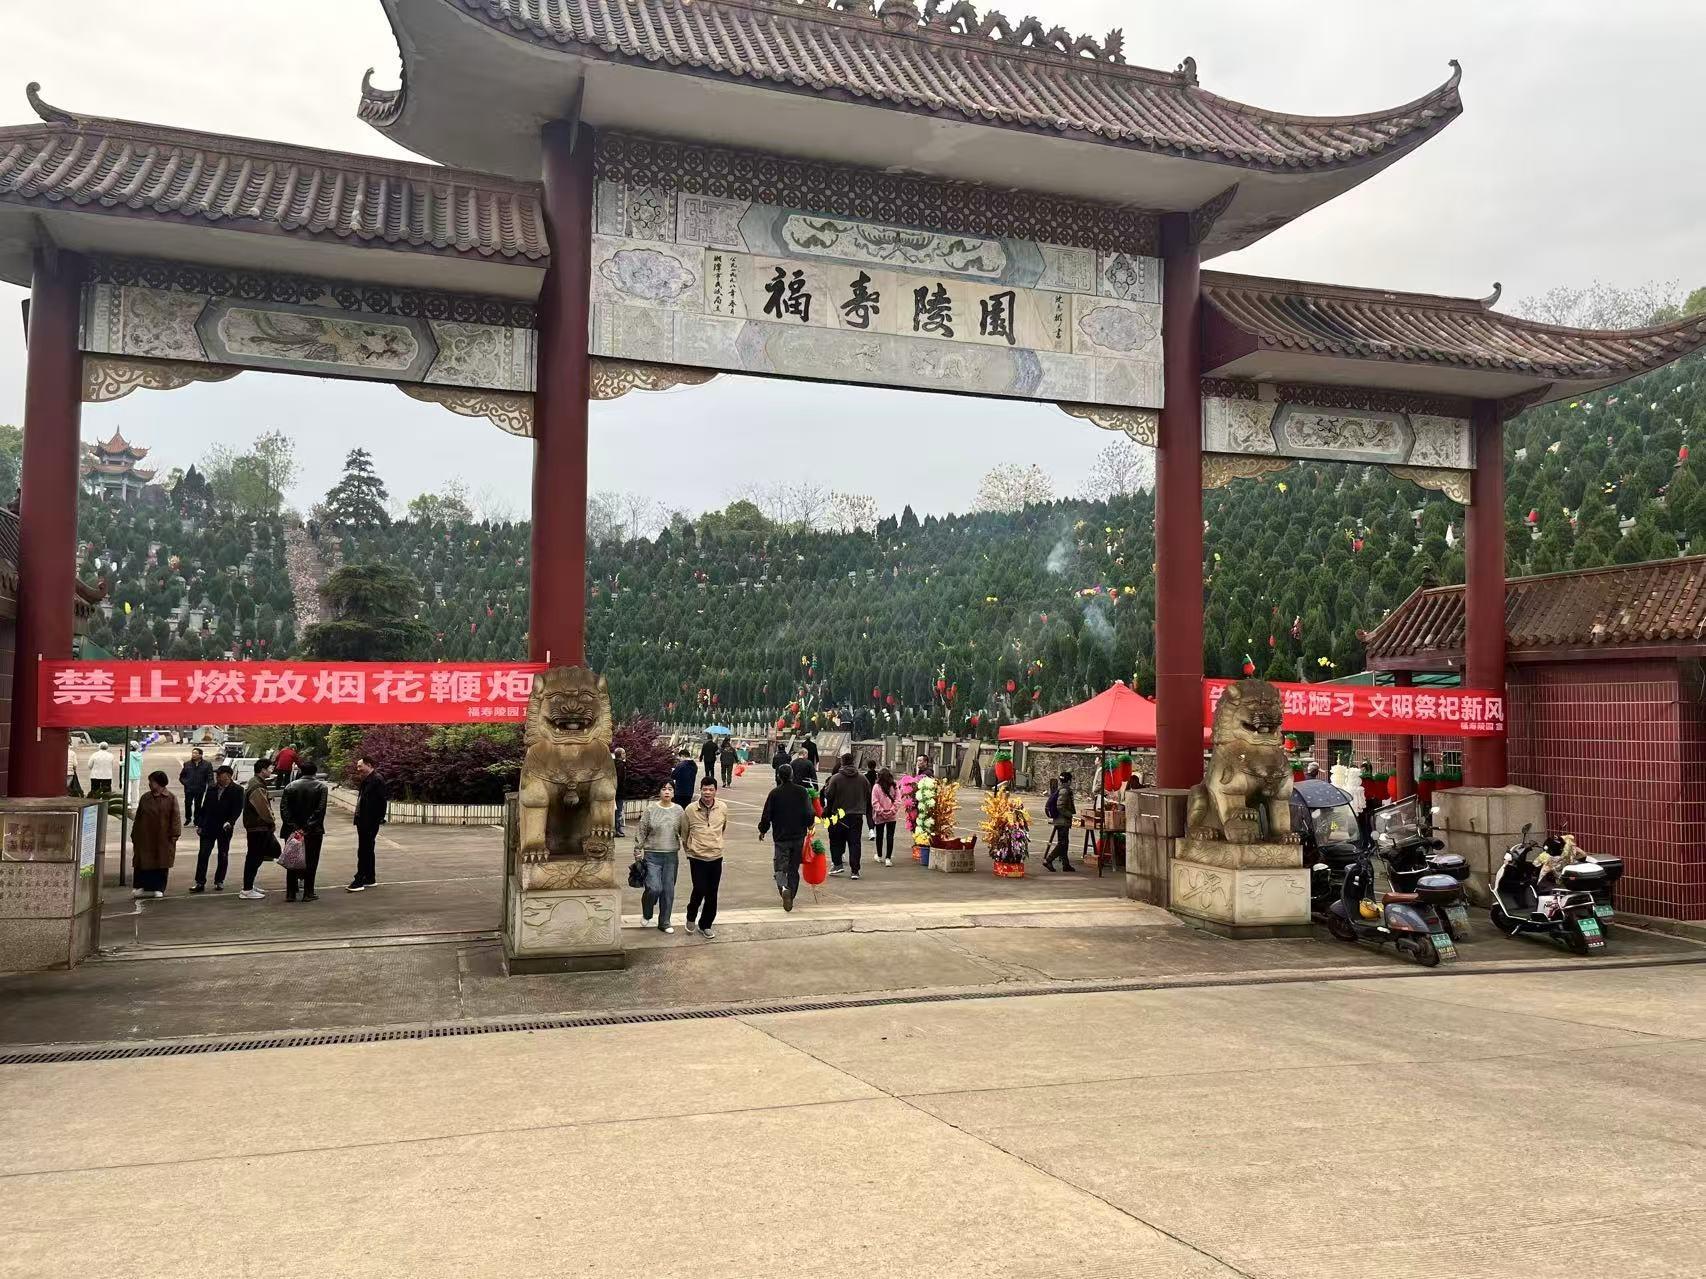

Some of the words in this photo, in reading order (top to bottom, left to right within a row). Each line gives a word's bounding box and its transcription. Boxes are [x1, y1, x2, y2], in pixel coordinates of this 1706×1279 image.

[52, 668, 535, 704] 禁止燃放烟花鞭炮
[467, 706, 519, 717] 福寿陵园
[1367, 692, 1504, 721] 文明祭祀新风
